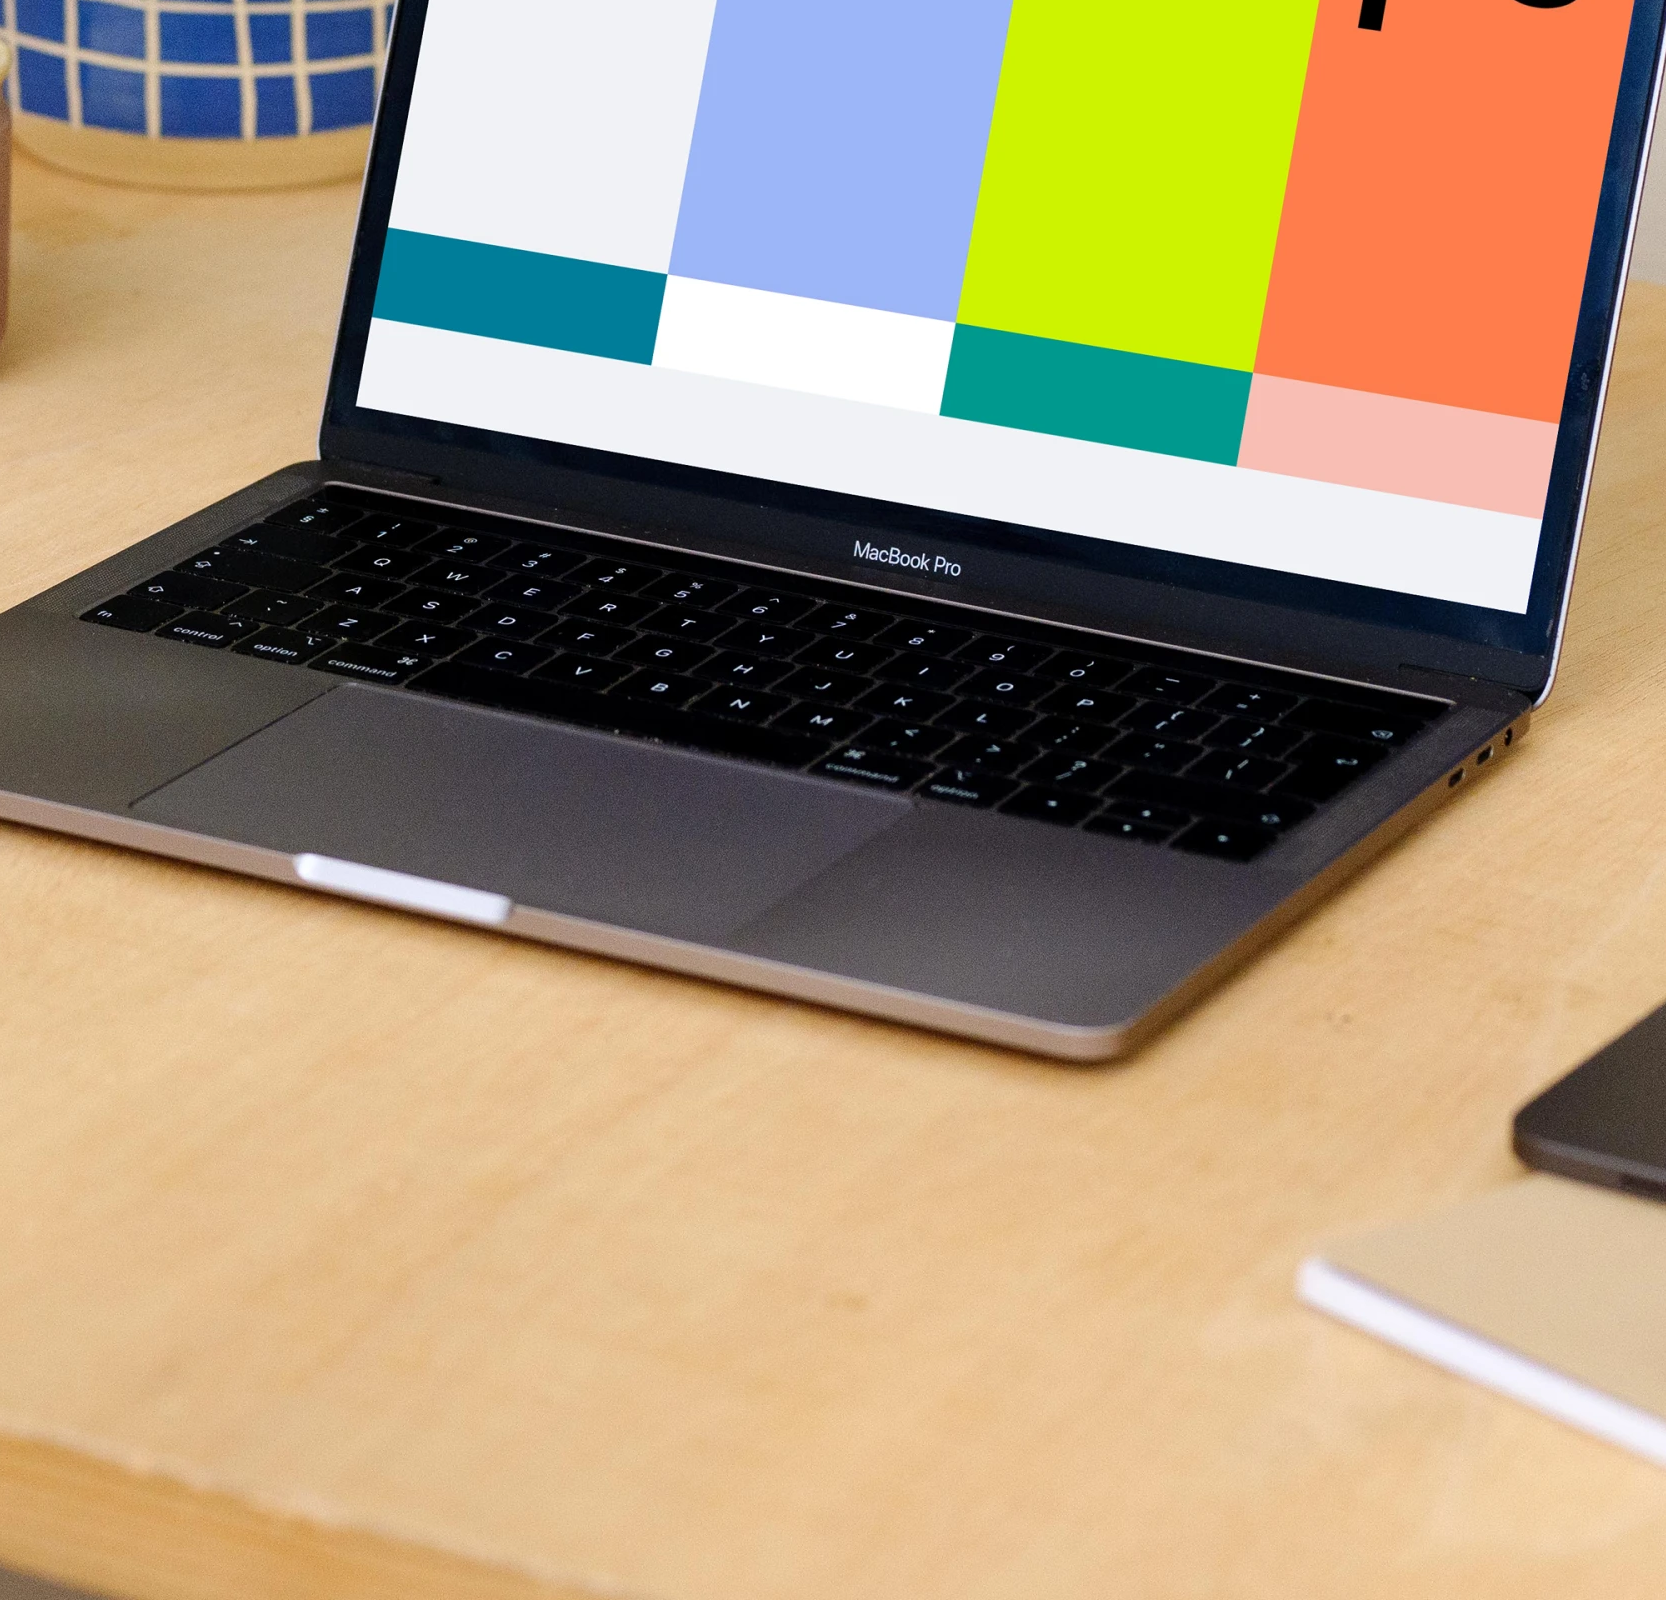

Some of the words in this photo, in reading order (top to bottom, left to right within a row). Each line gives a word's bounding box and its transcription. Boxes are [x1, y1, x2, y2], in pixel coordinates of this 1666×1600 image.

[376, 531, 388, 539] 1
[446, 545, 464, 554] 2
[521, 559, 539, 568] 3
[597, 575, 615, 583] 4
[673, 590, 691, 599] 5
[751, 605, 769, 614] 6
[830, 620, 847, 629] 7
[908, 636, 925, 646] 8
[988, 653, 1006, 662] 9
[1069, 668, 1086, 678] 0
[853, 539, 931, 572] MacBook
[933, 555, 962, 577] Pro
[97, 610, 113, 618] fn
[173, 626, 224, 642] control
[253, 643, 299, 658] option
[327, 658, 398, 679] command
[338, 617, 359, 628] Z
[414, 633, 436, 644] X
[494, 650, 513, 660] C
[574, 665, 593, 676] V
[650, 682, 669, 693] B
[729, 698, 751, 710] N
[809, 714, 834, 727] M
[345, 586, 363, 595] A
[422, 600, 441, 610] S
[497, 616, 517, 626] D
[576, 632, 595, 641] F
[654, 648, 674, 658] G
[732, 664, 754, 675] H
[814, 681, 832, 690] J
[893, 696, 913, 707] K
[976, 713, 988, 724] L
[373, 557, 392, 567] Q
[446, 571, 470, 582] W
[522, 587, 541, 597] E
[598, 602, 618, 613] R
[680, 618, 697, 628] T
[758, 634, 775, 644] Y
[834, 650, 855, 660] U
[995, 682, 1015, 692] O
[1076, 698, 1095, 707] P
